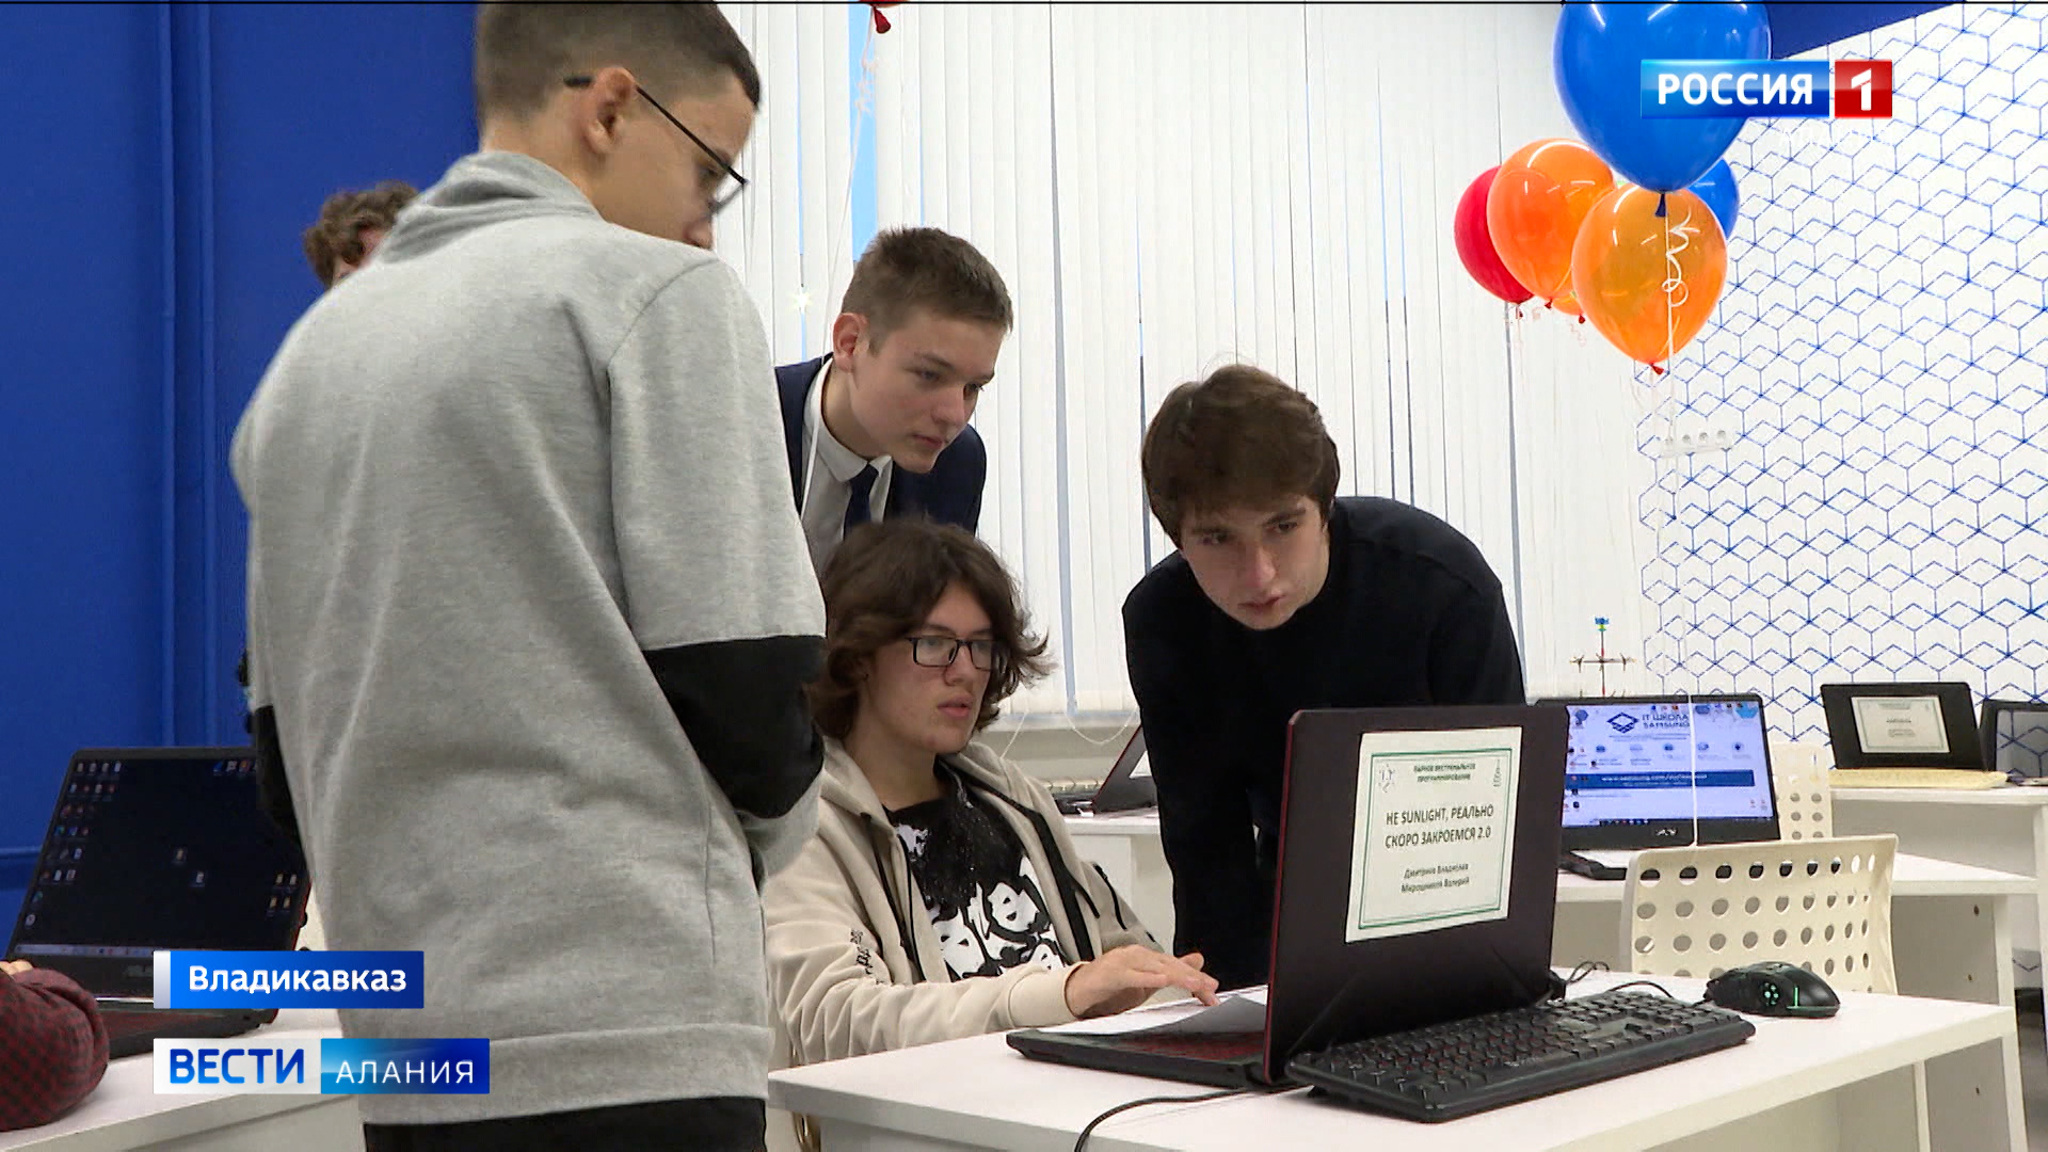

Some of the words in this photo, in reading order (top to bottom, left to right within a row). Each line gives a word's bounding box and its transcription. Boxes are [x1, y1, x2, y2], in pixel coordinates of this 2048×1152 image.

[1652, 713, 1690, 721] ШКОЛА
[1386, 811, 1399, 826] НЕ
[1401, 807, 1449, 824] SUNLIGHT,
[1451, 803, 1494, 820] РЕАЛЬНО
[1385, 832, 1419, 849] СКОРО
[1421, 826, 1475, 845] ЗАКРОЕМСЯ
[1477, 825, 1491, 839] 2.0
